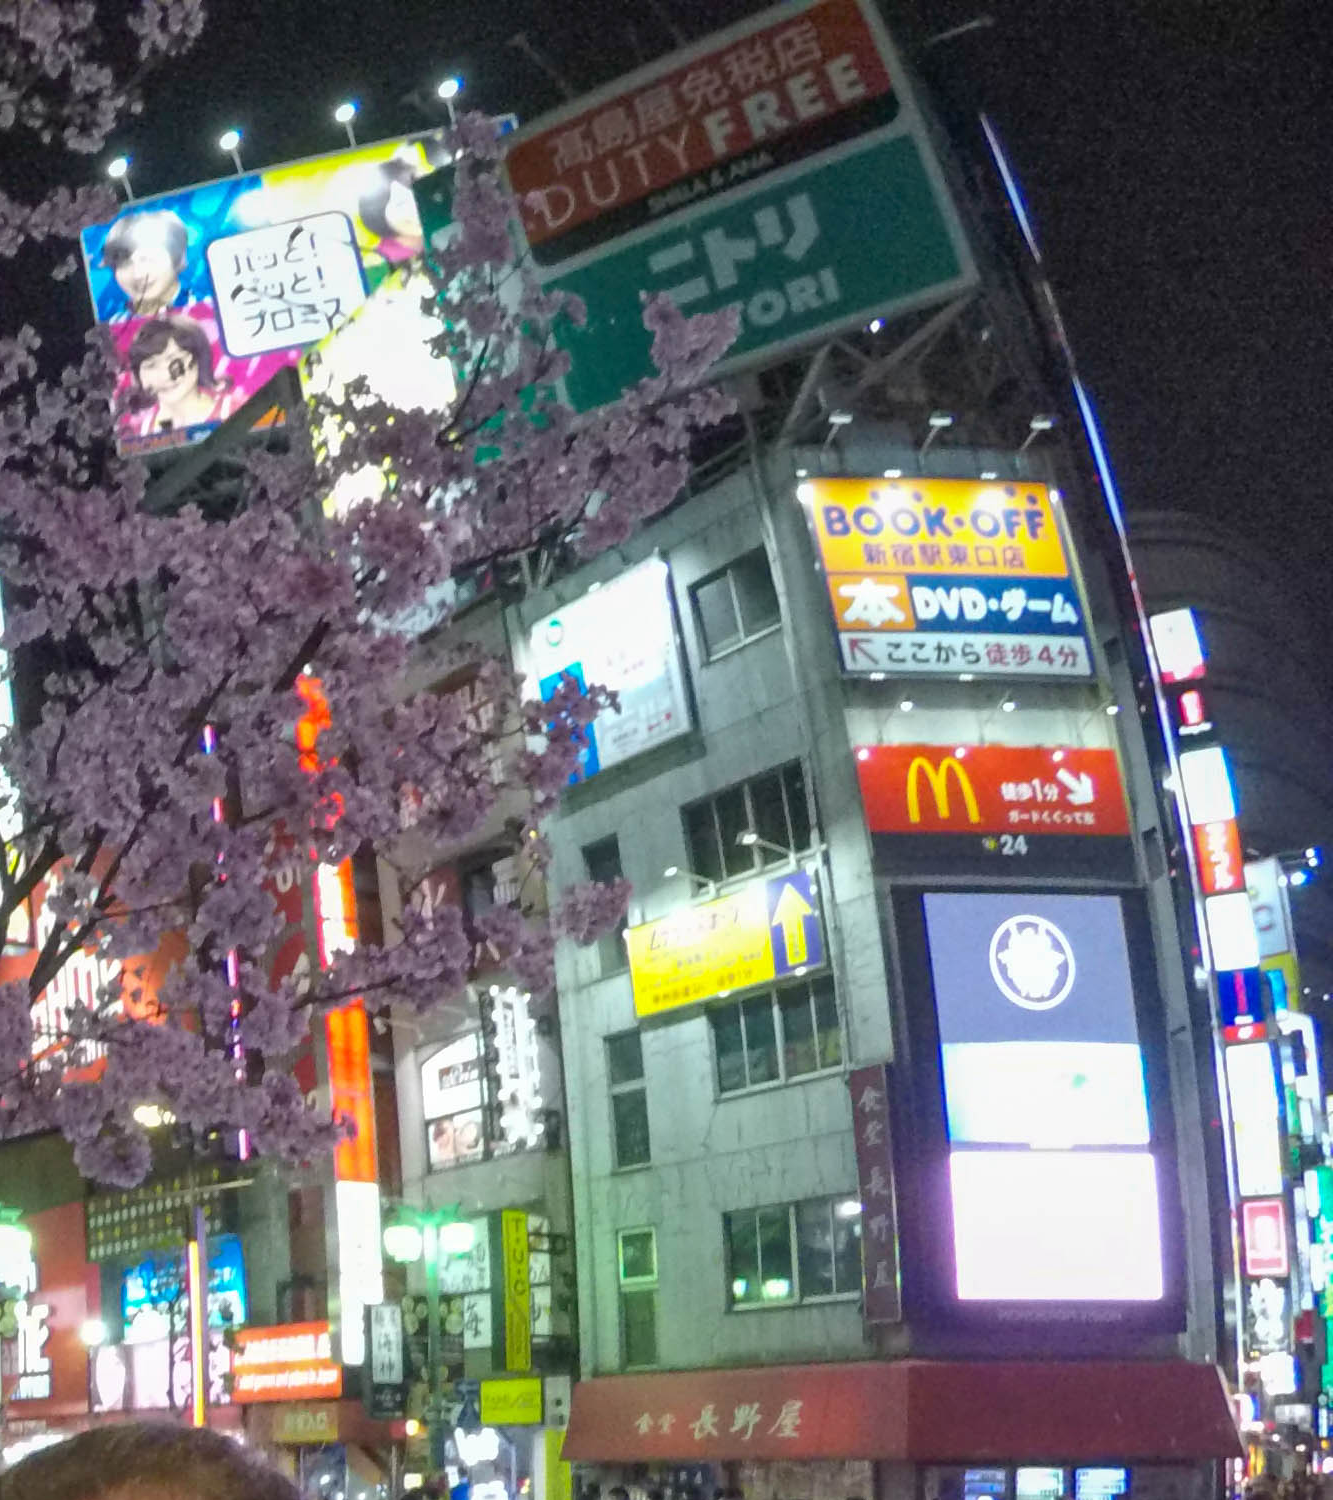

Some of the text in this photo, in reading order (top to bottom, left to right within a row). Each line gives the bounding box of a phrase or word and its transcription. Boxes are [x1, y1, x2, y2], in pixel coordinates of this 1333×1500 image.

[541, 52, 867, 228] DUTY FREE
[649, 193, 820, 305] ニトリ
[863, 544, 1025, 569] 新宿駅東口店
[838, 577, 906, 627] 本
[886, 642, 1078, 668] ここから徒歩4分
[1000, 834, 1028, 856] 24
